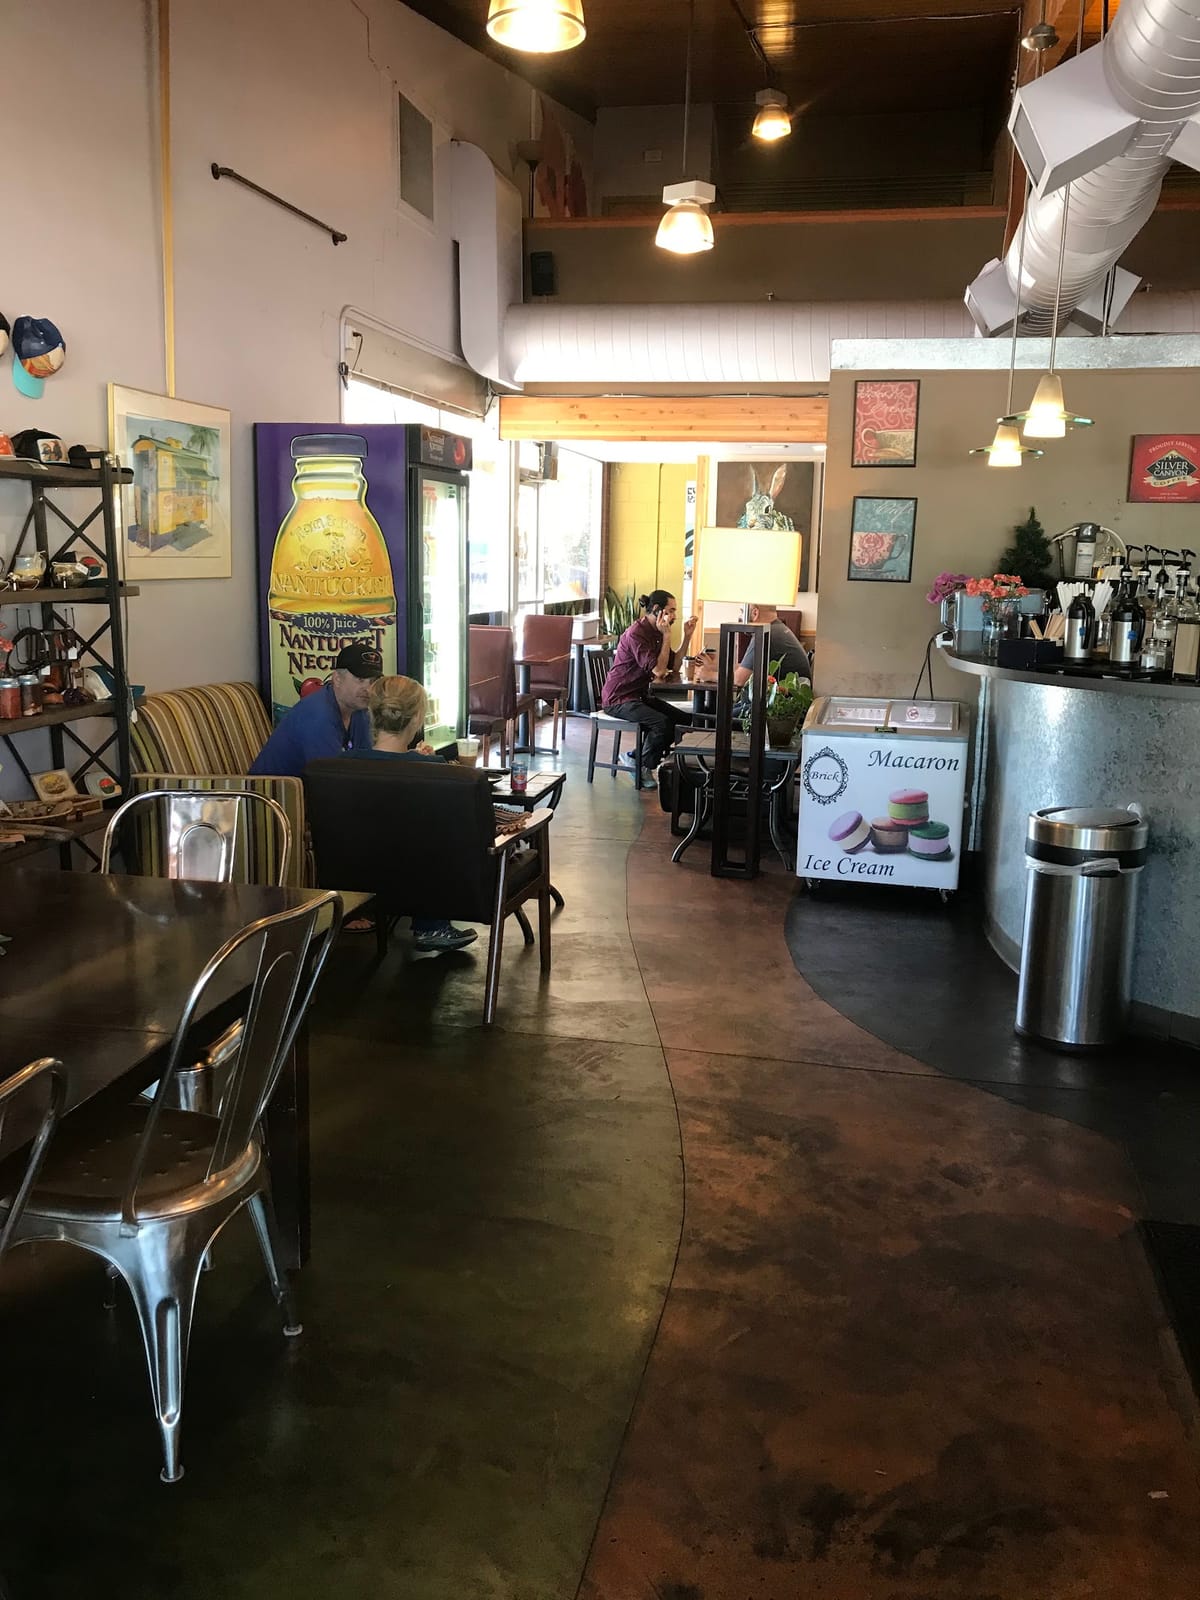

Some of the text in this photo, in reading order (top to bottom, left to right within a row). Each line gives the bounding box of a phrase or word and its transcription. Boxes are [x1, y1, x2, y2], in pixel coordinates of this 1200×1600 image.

[1148, 440, 1198, 454] PROUDLY SERVING
[1153, 469, 1188, 477] CANYON
[1154, 461, 1189, 470] SILVER
[1153, 476, 1187, 485] COFFEE
[272, 572, 390, 597] NANTUCKET
[303, 616, 358, 633] 100% Juice
[279, 624, 386, 653] NANTUCKET
[287, 652, 338, 675] NECT
[868, 750, 960, 771] Macaron
[810, 771, 843, 783] Brick
[804, 854, 895, 876] Ice Cream
